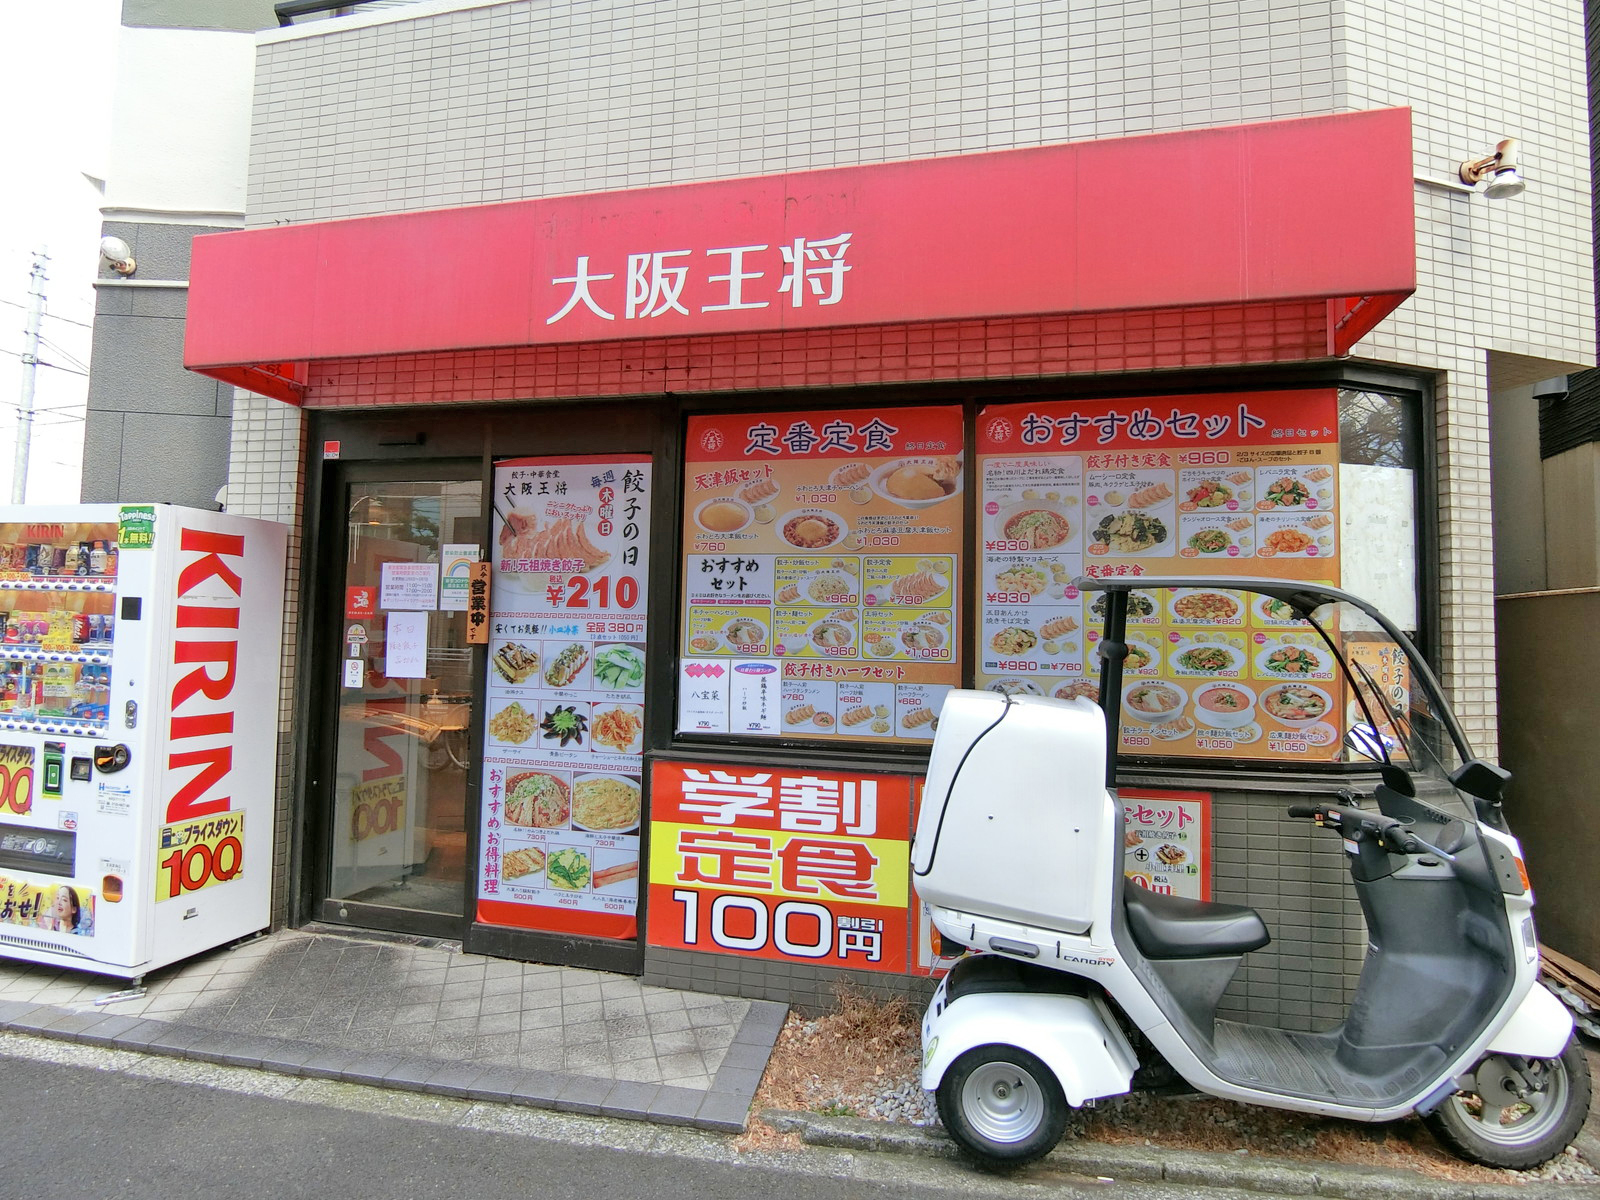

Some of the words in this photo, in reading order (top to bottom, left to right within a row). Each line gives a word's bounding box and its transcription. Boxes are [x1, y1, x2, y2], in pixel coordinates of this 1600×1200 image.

[546, 232, 853, 325] 大阪王将
[1021, 404, 1266, 445] おすすめセット
[744, 417, 898, 455] 定番定食
[1271, 427, 1331, 438] 終日セット
[1086, 453, 1171, 469] 餃子付き定食
[1178, 451, 1230, 464] ¥960
[511, 470, 561, 480] 餃子・中華食堂
[590, 470, 617, 488] 毎週
[693, 464, 773, 491] 天津飯セット
[503, 481, 568, 496] 大阪王将
[796, 494, 837, 503] ¥1,030
[118, 509, 157, 523] Tappiness
[598, 487, 614, 536] 木曜日
[621, 469, 645, 567] 餃子の日
[27, 525, 64, 538] KIRIN
[694, 543, 725, 551] ¥760
[857, 536, 899, 546] ¥1,030
[985, 541, 1029, 551] ¥930
[500, 559, 585, 572] 新!元祖焼き餃子
[701, 557, 759, 573] おすすめ
[1085, 564, 1145, 578] 定番定食
[710, 576, 747, 591] セット
[546, 575, 639, 609] ¥210
[825, 594, 857, 603] ¥960
[986, 592, 1031, 603] ¥930
[470, 579, 487, 626] 営業中
[889, 595, 923, 605] ¥790
[586, 622, 644, 633] 全品380円
[737, 644, 767, 653] ¥890
[825, 647, 857, 656] ¥960
[905, 648, 949, 658] ¥1,080
[784, 663, 905, 680] 餃子付きハーフセット
[998, 661, 1037, 671] ¥980
[1050, 663, 1082, 671] ¥760
[1138, 668, 1159, 676] ¥920
[166, 528, 245, 824] KIRIN
[1217, 670, 1239, 678] ¥920
[1311, 672, 1333, 680] ¥920
[691, 690, 720, 701] 八宝菜
[898, 698, 922, 706] ¥680
[1123, 727, 1179, 736] 餃子ラーメンセット
[1269, 731, 1325, 741] 広東麺炒飯セット
[1122, 736, 1150, 746] ¥890
[1197, 738, 1233, 749] ¥1,050
[1269, 741, 1306, 752] ¥1,050
[679, 768, 878, 836] 学割
[184, 815, 244, 846] ブライスダウン!
[483, 768, 503, 895] おすすめお得料理
[526, 833, 546, 841] 730円
[162, 836, 243, 898] 100
[677, 831, 878, 900] 定食
[8, 884, 14, 897] を
[673, 889, 833, 958] 100
[837, 916, 883, 931] 割引
[838, 930, 882, 962] 円
[1064, 955, 1114, 967] CANOPY
